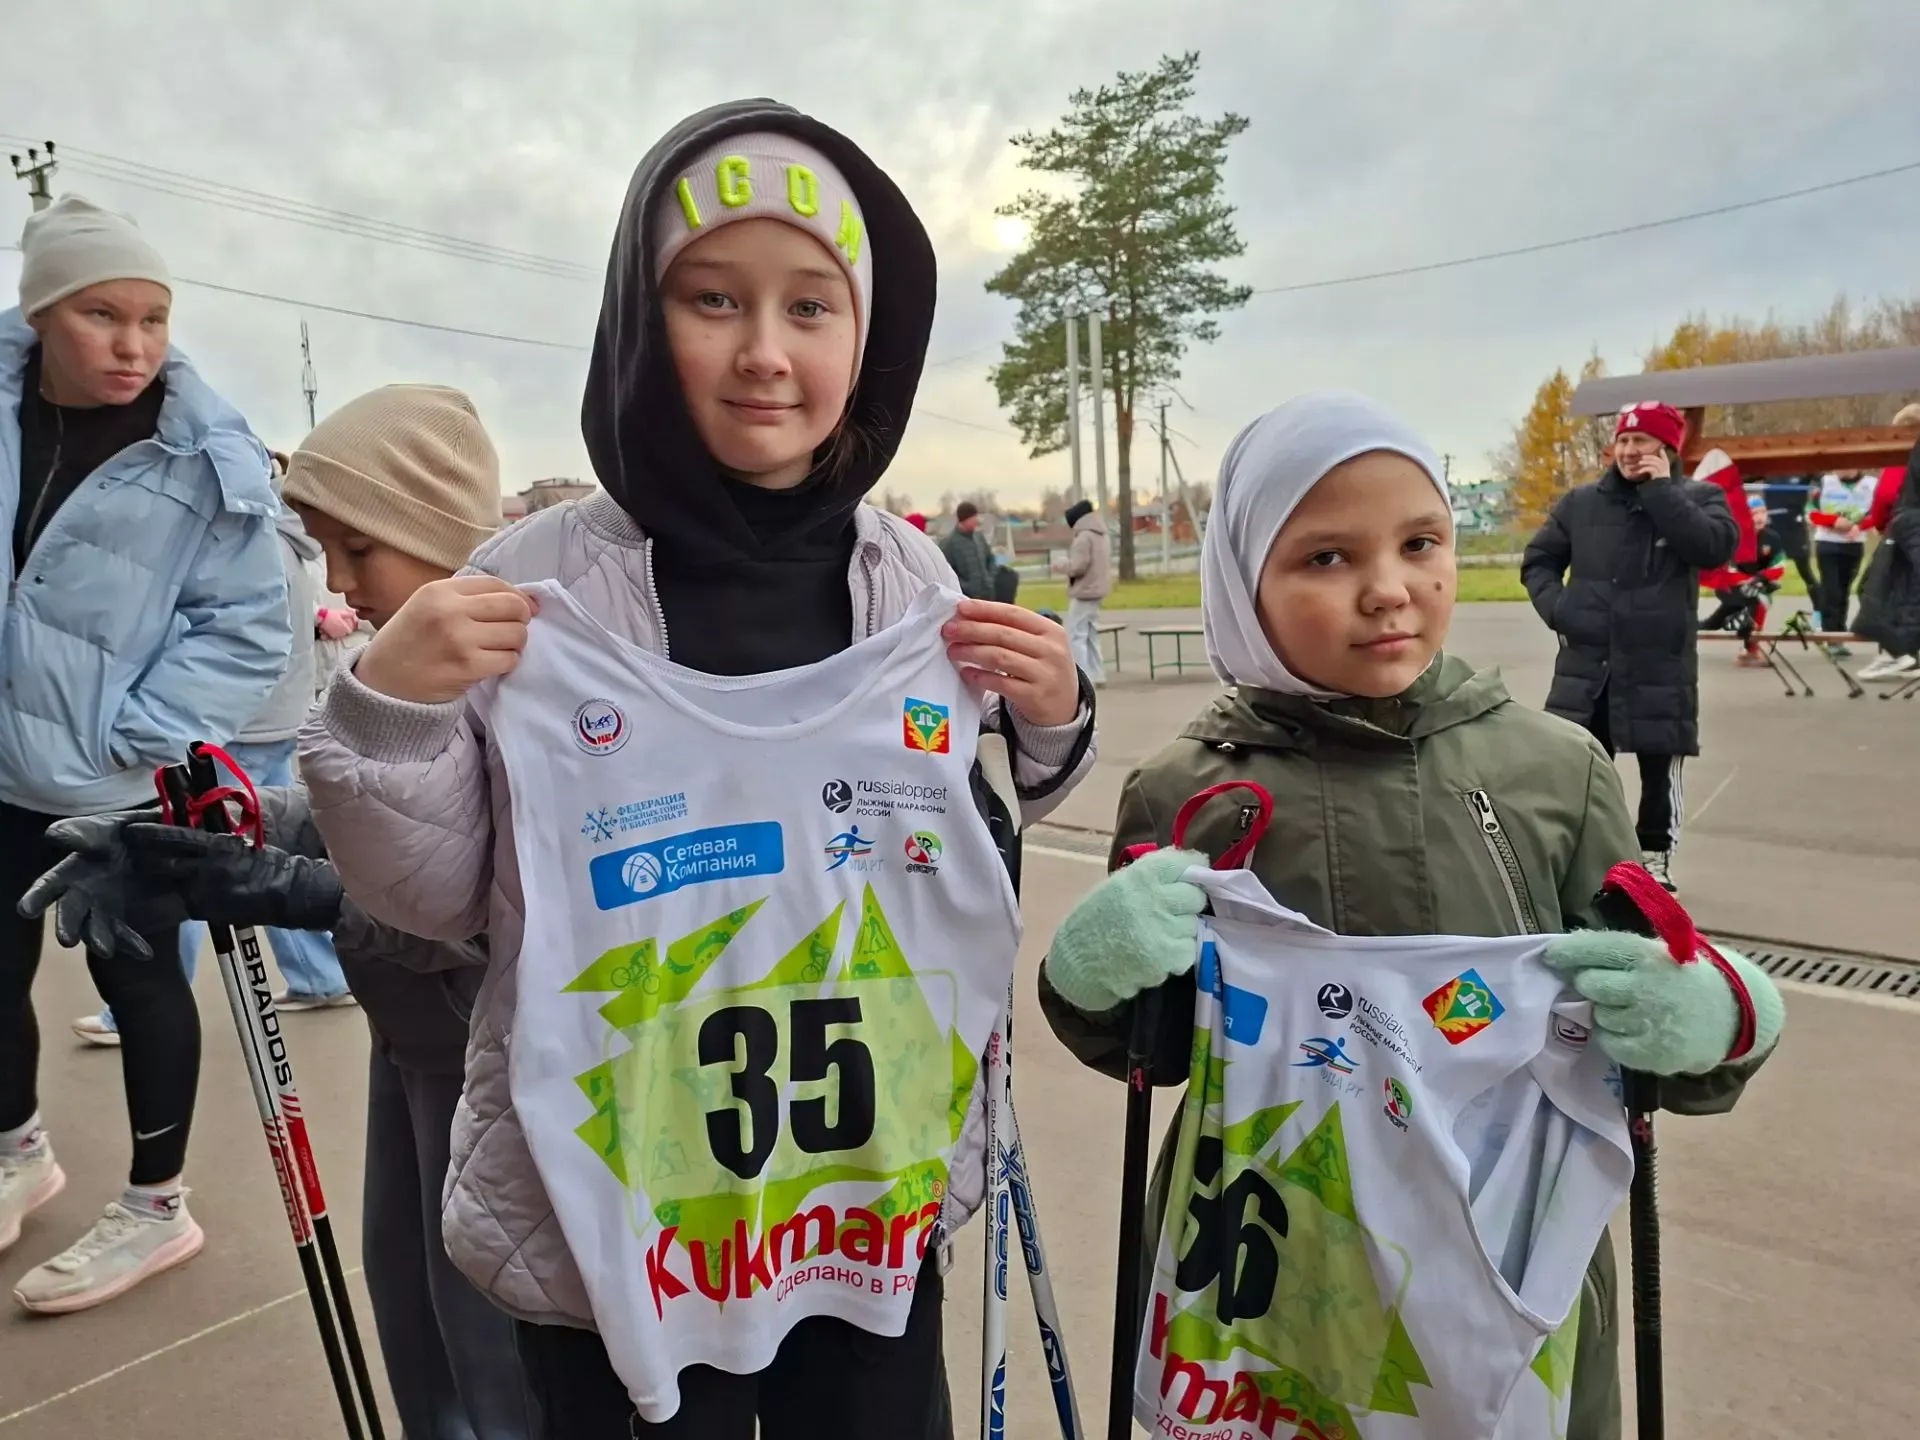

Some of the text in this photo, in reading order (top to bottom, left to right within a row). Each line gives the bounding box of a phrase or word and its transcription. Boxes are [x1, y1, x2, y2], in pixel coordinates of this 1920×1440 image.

[857, 780, 948, 800] russialoppet
[616, 792, 686, 816] ФЕДЕРАЦИЯ
[619, 809, 659, 825] ЛЫЖНЫХ
[856, 808, 891, 817] РОССИИ
[857, 798, 946, 814] ЛЫЖНЫЕ МАРАФОНЫ
[629, 813, 677, 829] БИАТЛОНА
[678, 808, 689, 818] РТ
[663, 838, 737, 864] Сетевая
[666, 854, 757, 882] Компания
[241, 936, 292, 1087] BRADOS
[698, 997, 876, 1180] 35
[988, 1099, 997, 1243] COMPOSITE SHAFT
[646, 1201, 940, 1323] Kukmara
[777, 1265, 864, 1302] Сделано
